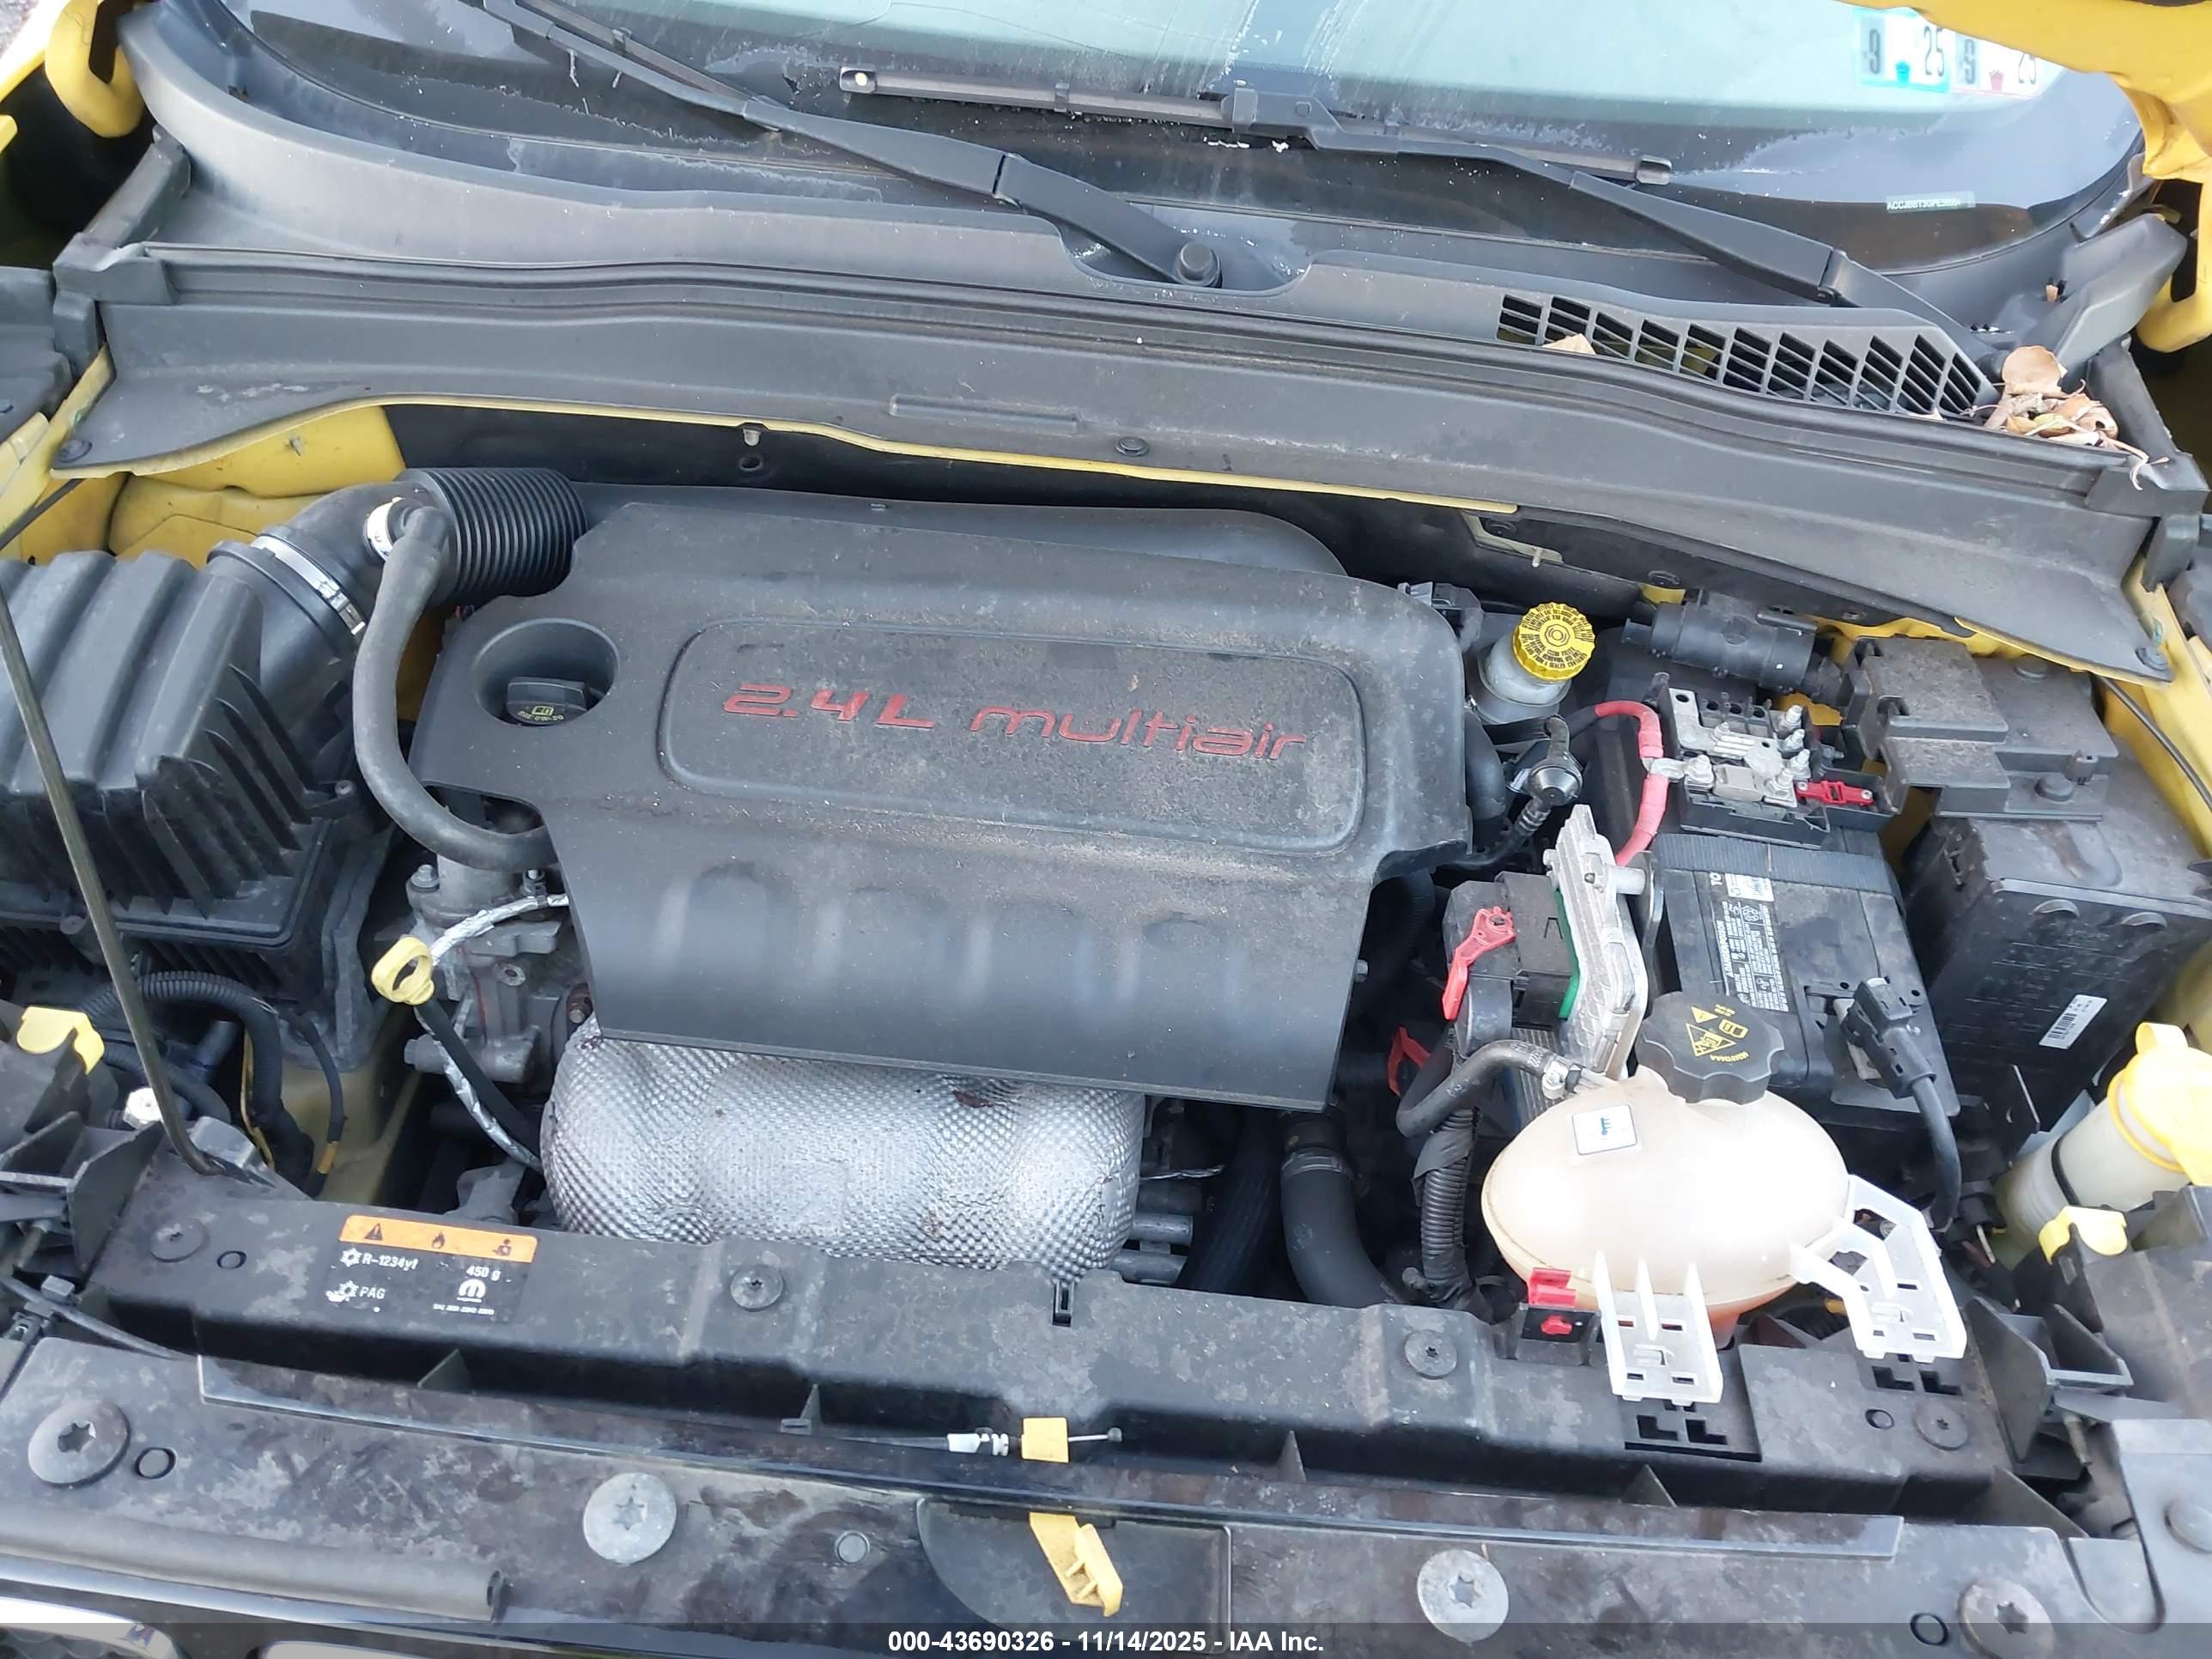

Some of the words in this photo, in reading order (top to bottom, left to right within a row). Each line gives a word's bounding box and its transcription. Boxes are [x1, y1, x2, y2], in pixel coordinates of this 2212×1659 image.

[1923, 24, 1946, 77] 25
[969, 705, 1307, 762] multiair
[362, 1251, 419, 1272] R-1234yf
[465, 1265, 489, 1279] 450
[491, 1268, 501, 1282] g
[359, 1285, 386, 1300] PAG
